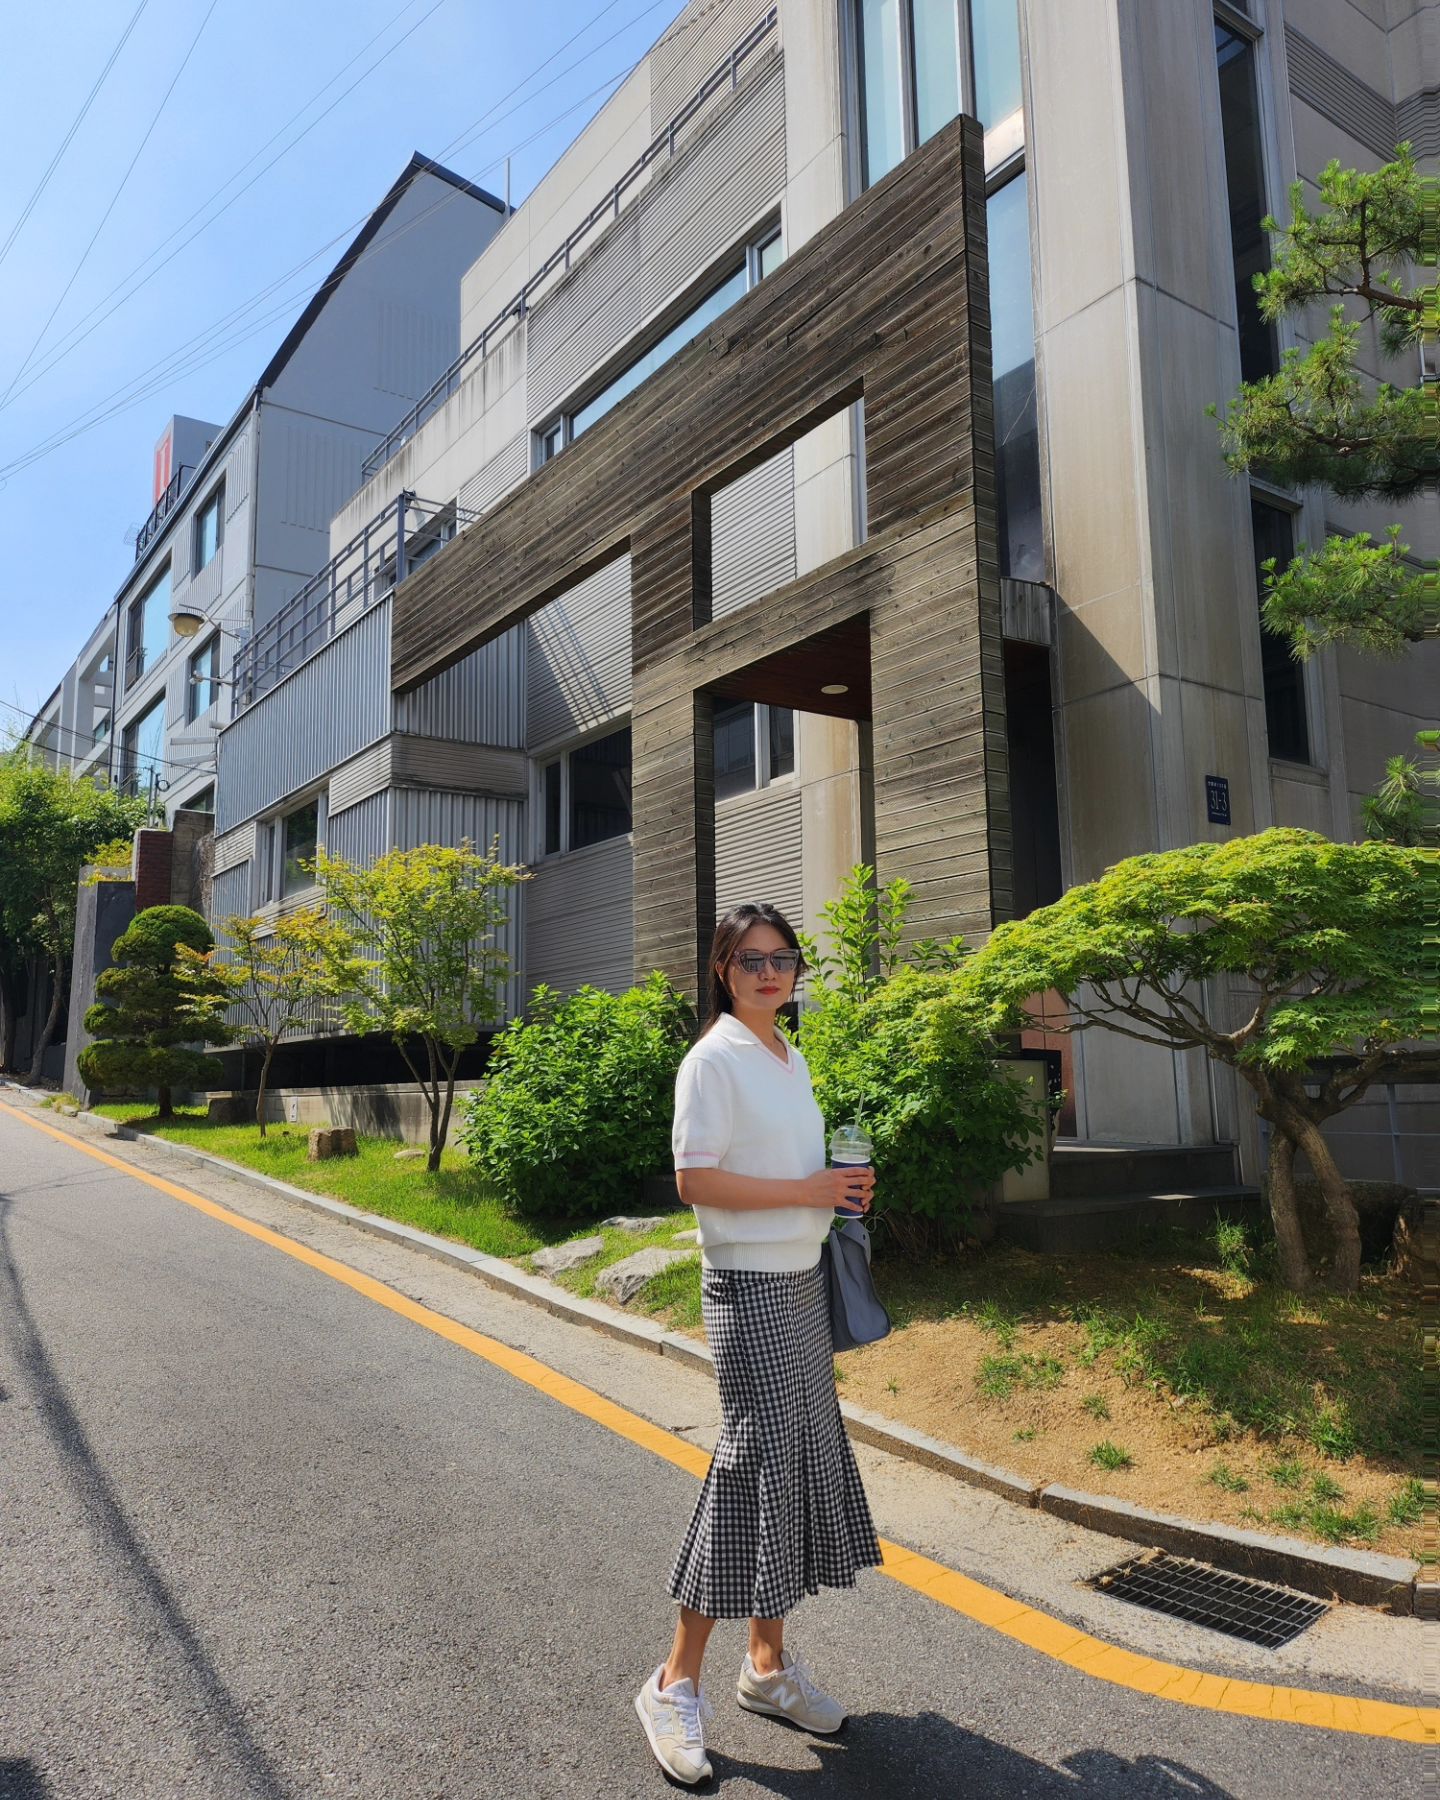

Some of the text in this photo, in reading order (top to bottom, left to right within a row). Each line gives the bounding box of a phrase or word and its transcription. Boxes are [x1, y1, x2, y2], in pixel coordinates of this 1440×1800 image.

[1210, 790, 1228, 811] 31-3
[770, 1684, 799, 1710] N
[653, 1711, 674, 1734] N
